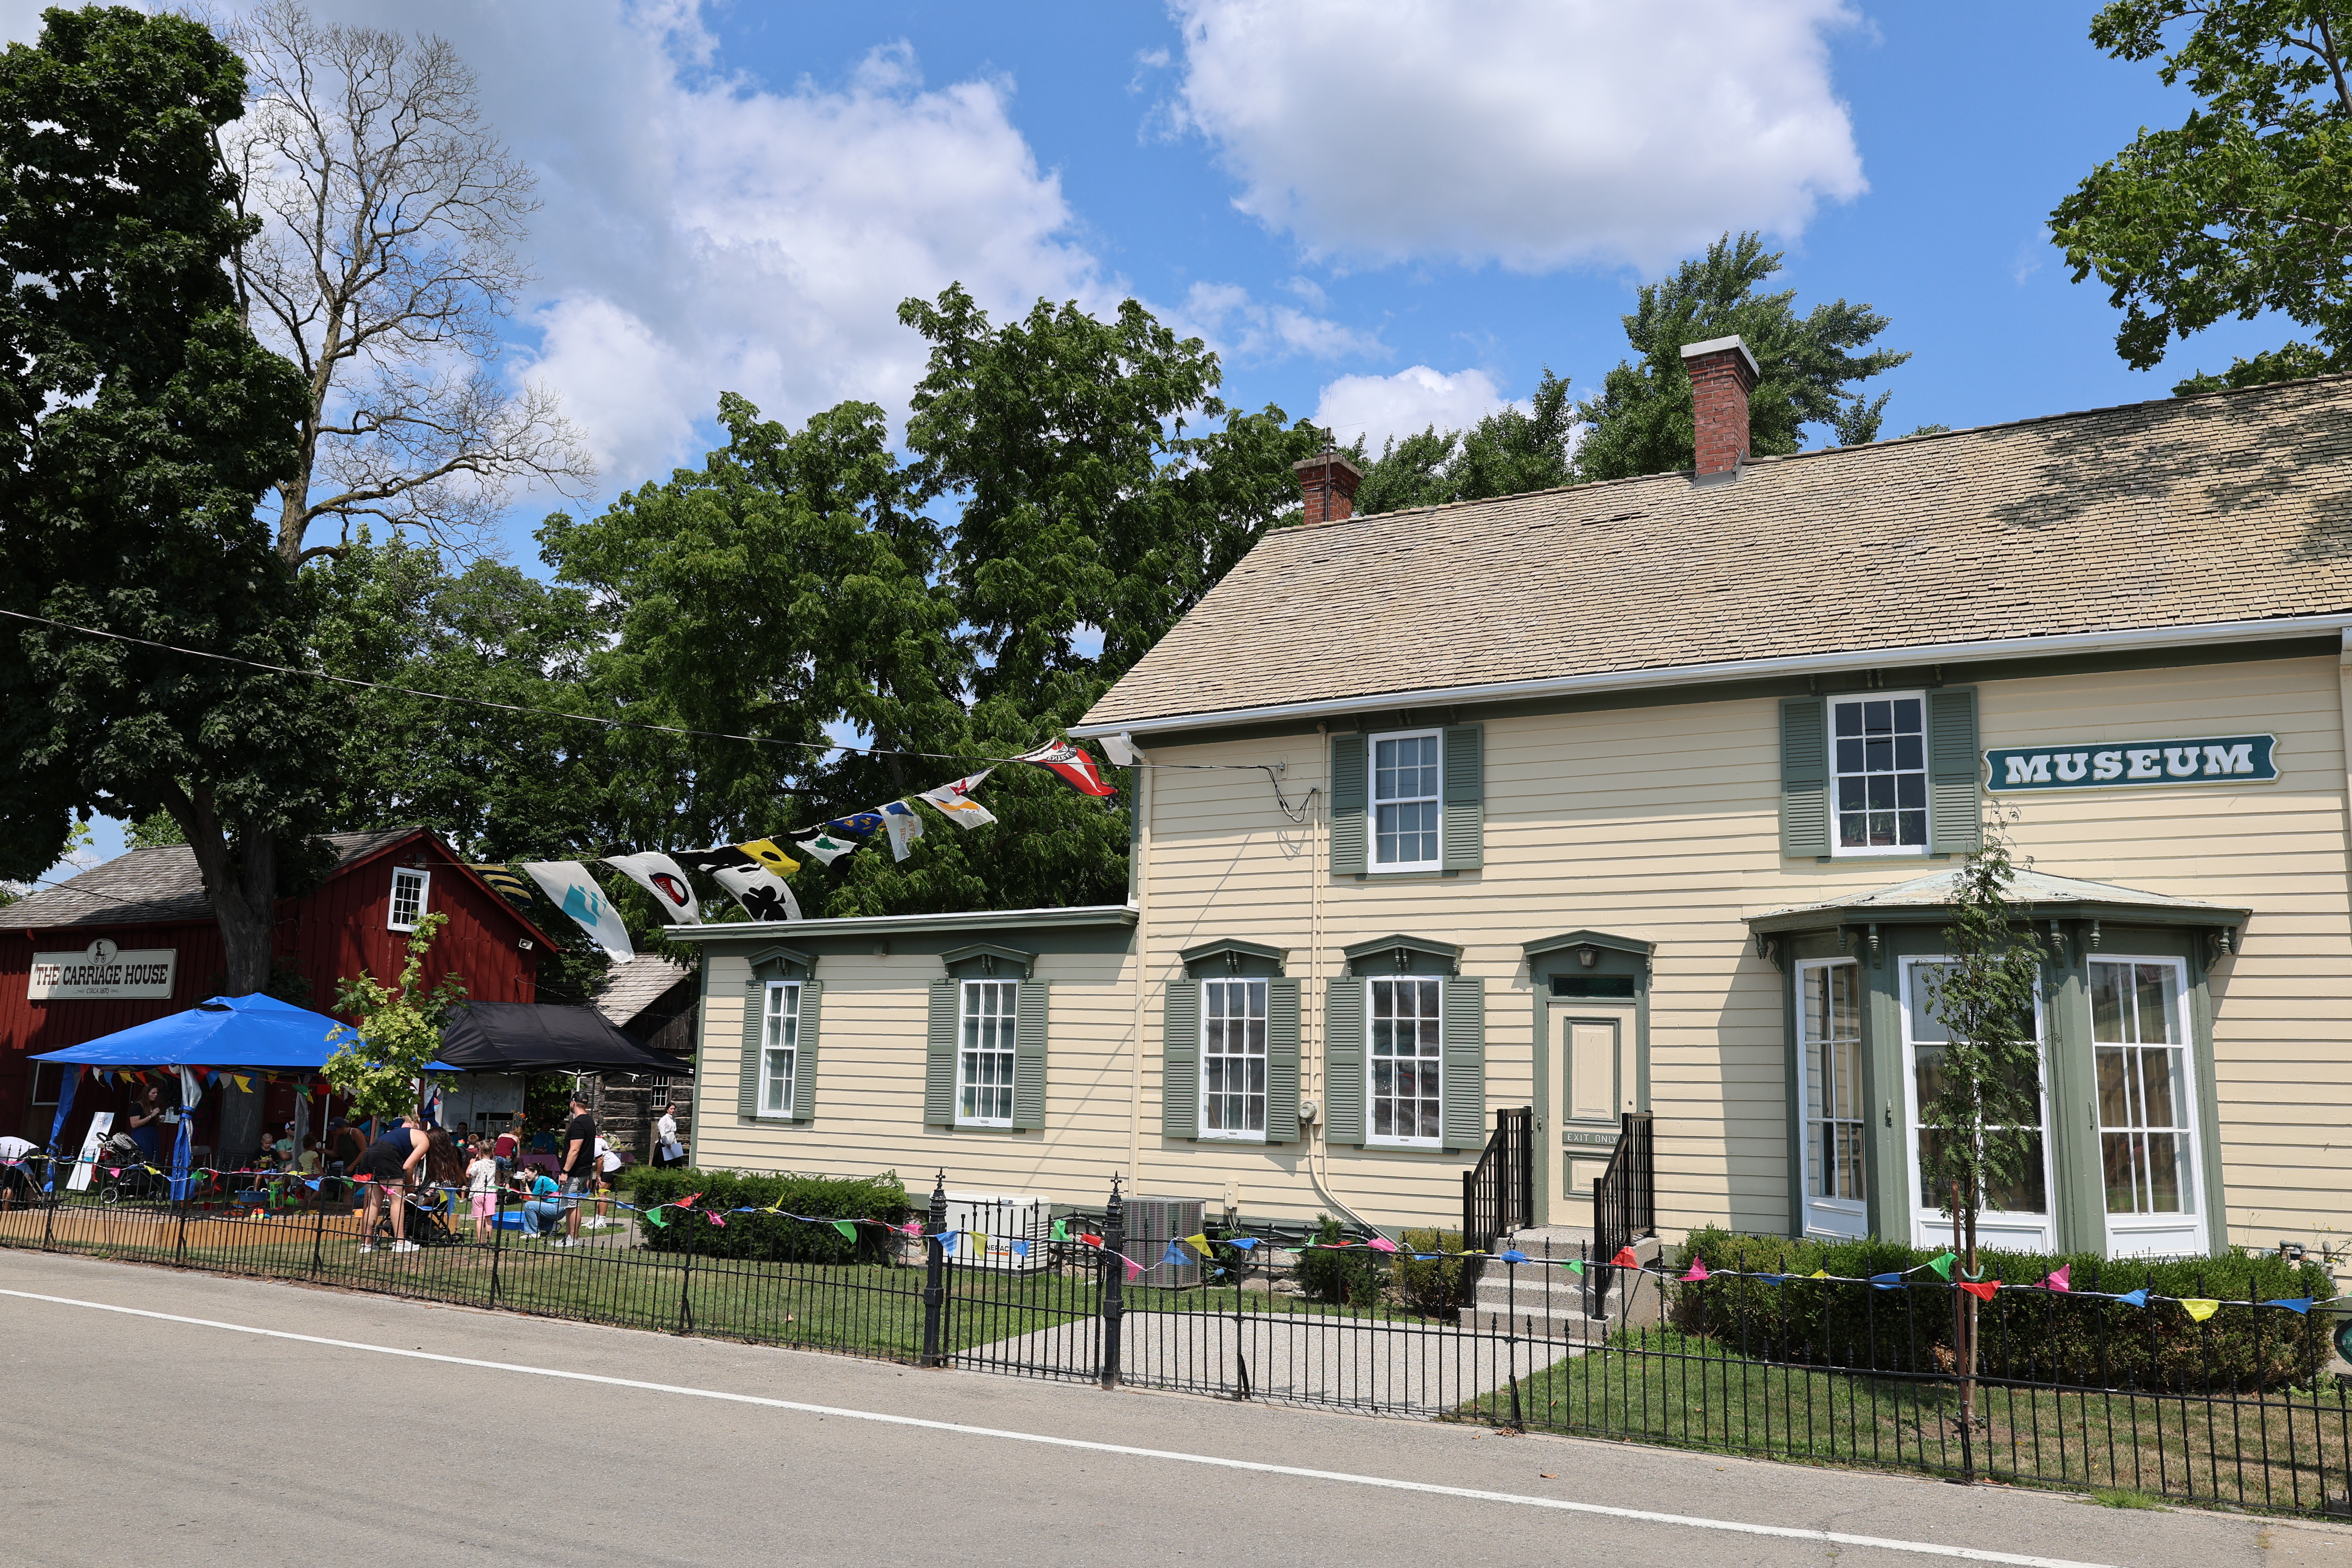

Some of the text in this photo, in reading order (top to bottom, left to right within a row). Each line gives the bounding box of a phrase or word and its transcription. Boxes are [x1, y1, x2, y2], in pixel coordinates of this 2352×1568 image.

[2005, 744, 2254, 784] MUSEUM
[36, 964, 168, 985] THE CARRIAGE HOUSE
[1568, 1133, 1617, 1143] EXIT ONLY
